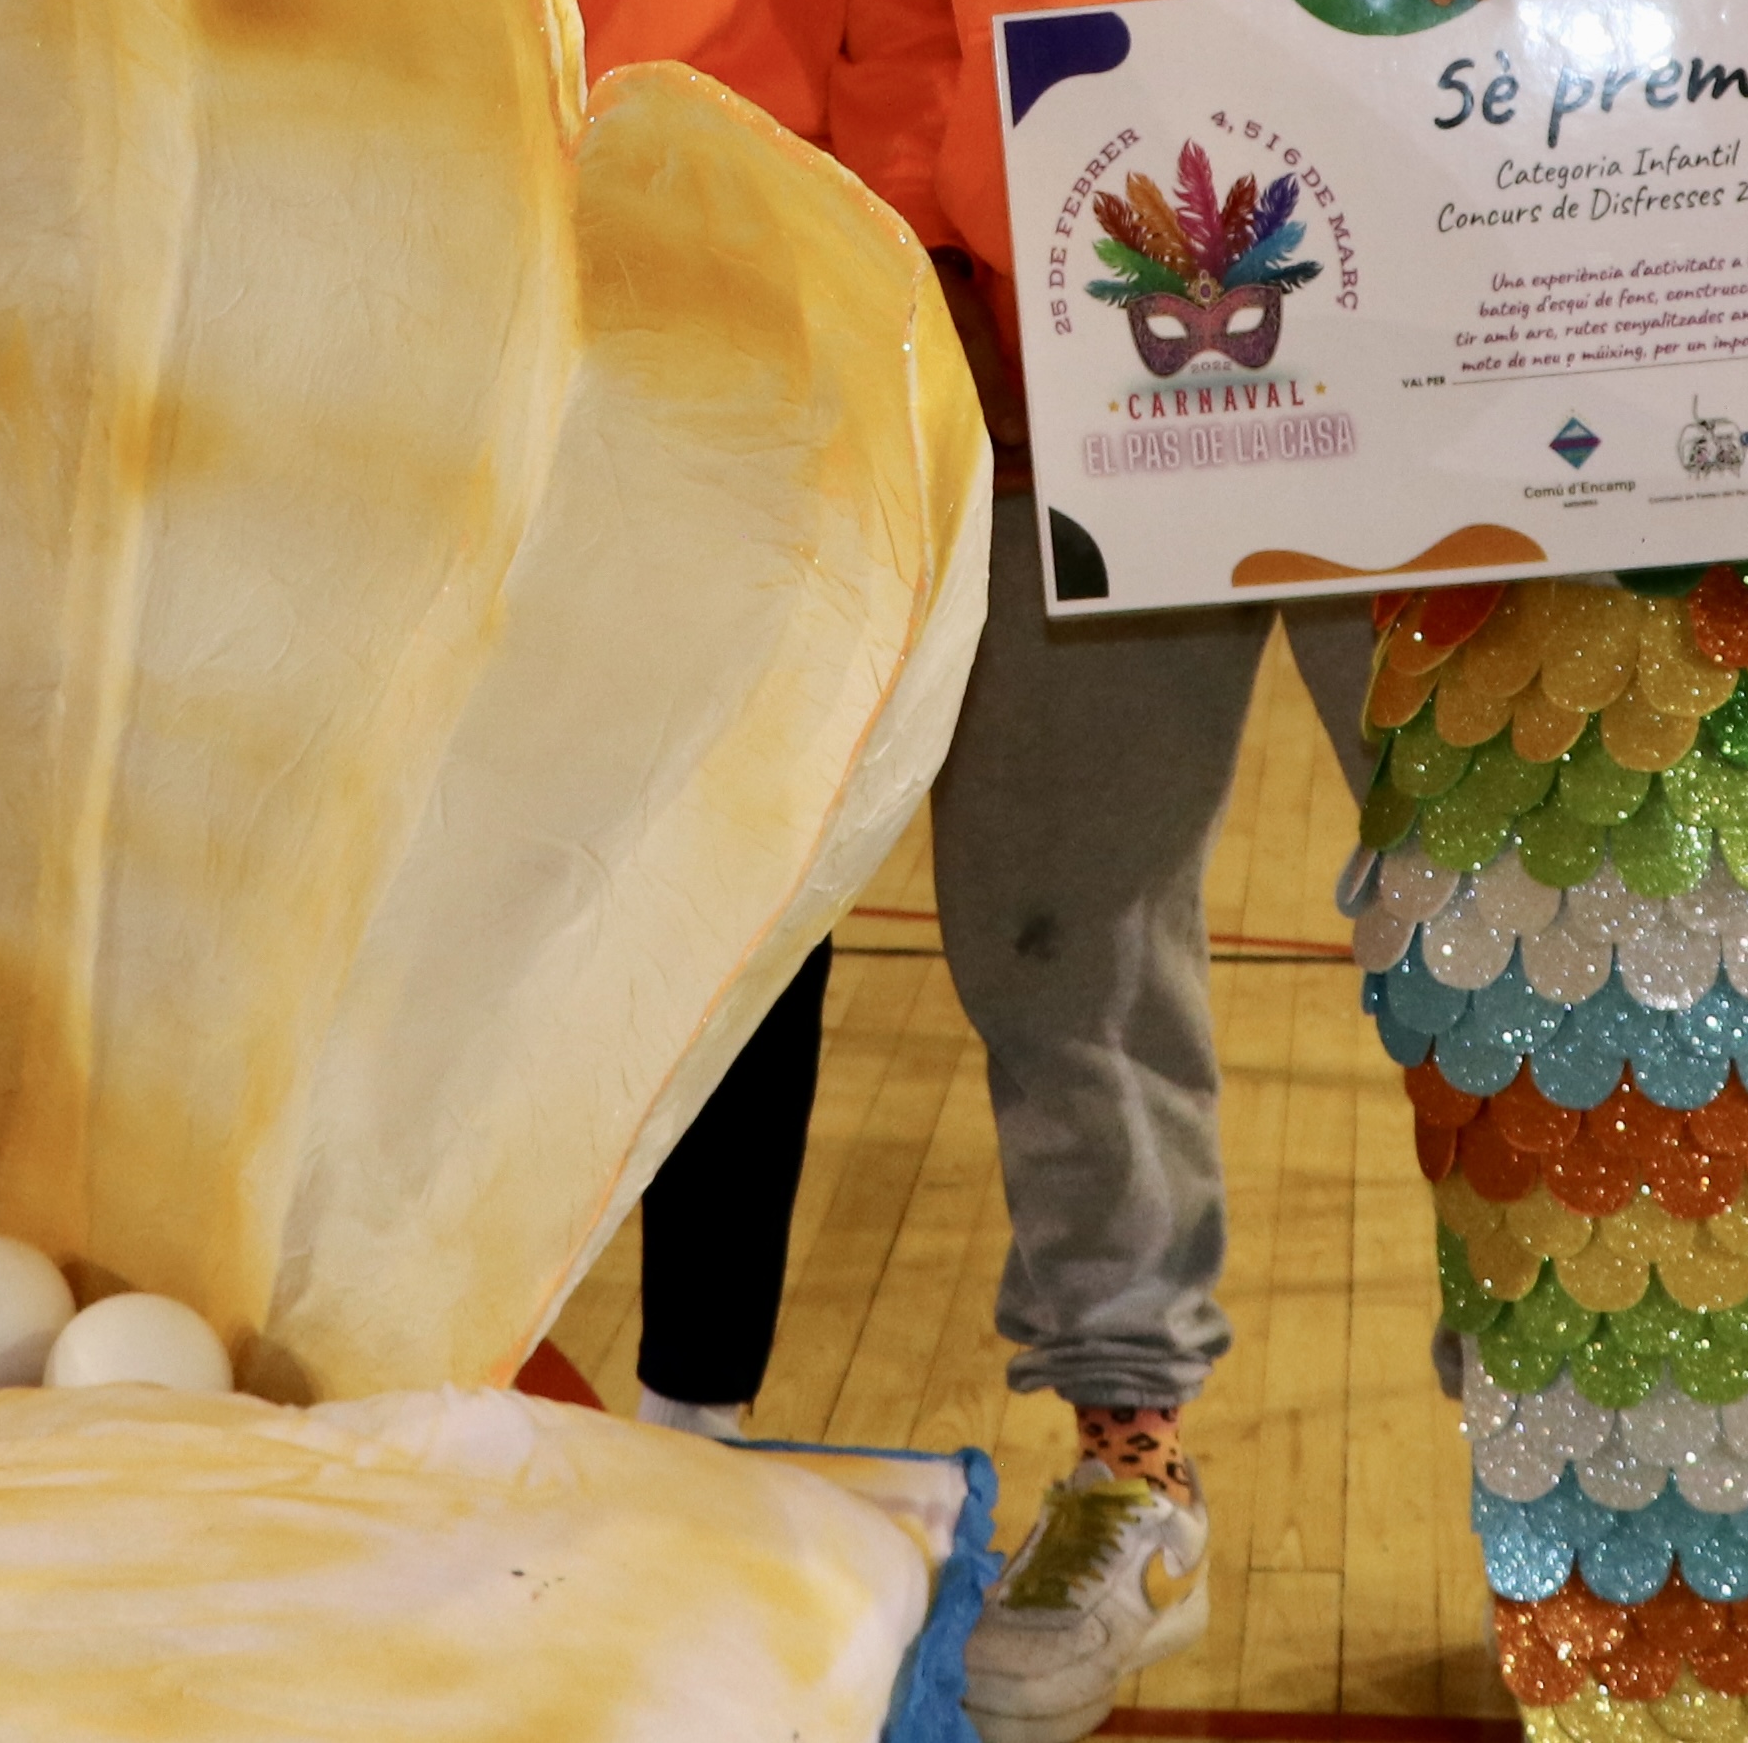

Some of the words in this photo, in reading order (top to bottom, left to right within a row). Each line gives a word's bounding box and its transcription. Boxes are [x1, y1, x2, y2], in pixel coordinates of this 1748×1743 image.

[1055, 128, 1141, 239] FEBRER
[1497, 157, 1622, 190] Categoria
[1632, 139, 1741, 178] Infantil
[1301, 166, 1335, 208] DE
[1438, 202, 1542, 234] Concurs
[1552, 194, 1579, 220] de
[1589, 185, 1726, 223] Disfresses
[1049, 246, 1067, 290] DE
[1491, 272, 1525, 292] Una
[1479, 301, 1531, 320] bateig
[1595, 290, 1613, 308] de
[1456, 332, 1477, 347] tir
[1483, 325, 1520, 343] amb
[1565, 321, 1609, 337] rutes
[1614, 311, 1725, 336] senyalitzades
[1191, 360, 1232, 374] 2022
[1462, 357, 1502, 373] moto
[1507, 351, 1527, 369] de
[1532, 353, 1561, 365] neu
[1653, 342, 1679, 361] per
[1687, 340, 1706, 352] un
[1127, 380, 1304, 421] CARNAVAL
[1402, 379, 1424, 389] VAL
[1086, 437, 1116, 475] EL
[1127, 430, 1181, 471] PAS
[1191, 425, 1223, 466] DE
[1235, 421, 1269, 462] LA
[1279, 416, 1354, 459] CASA
